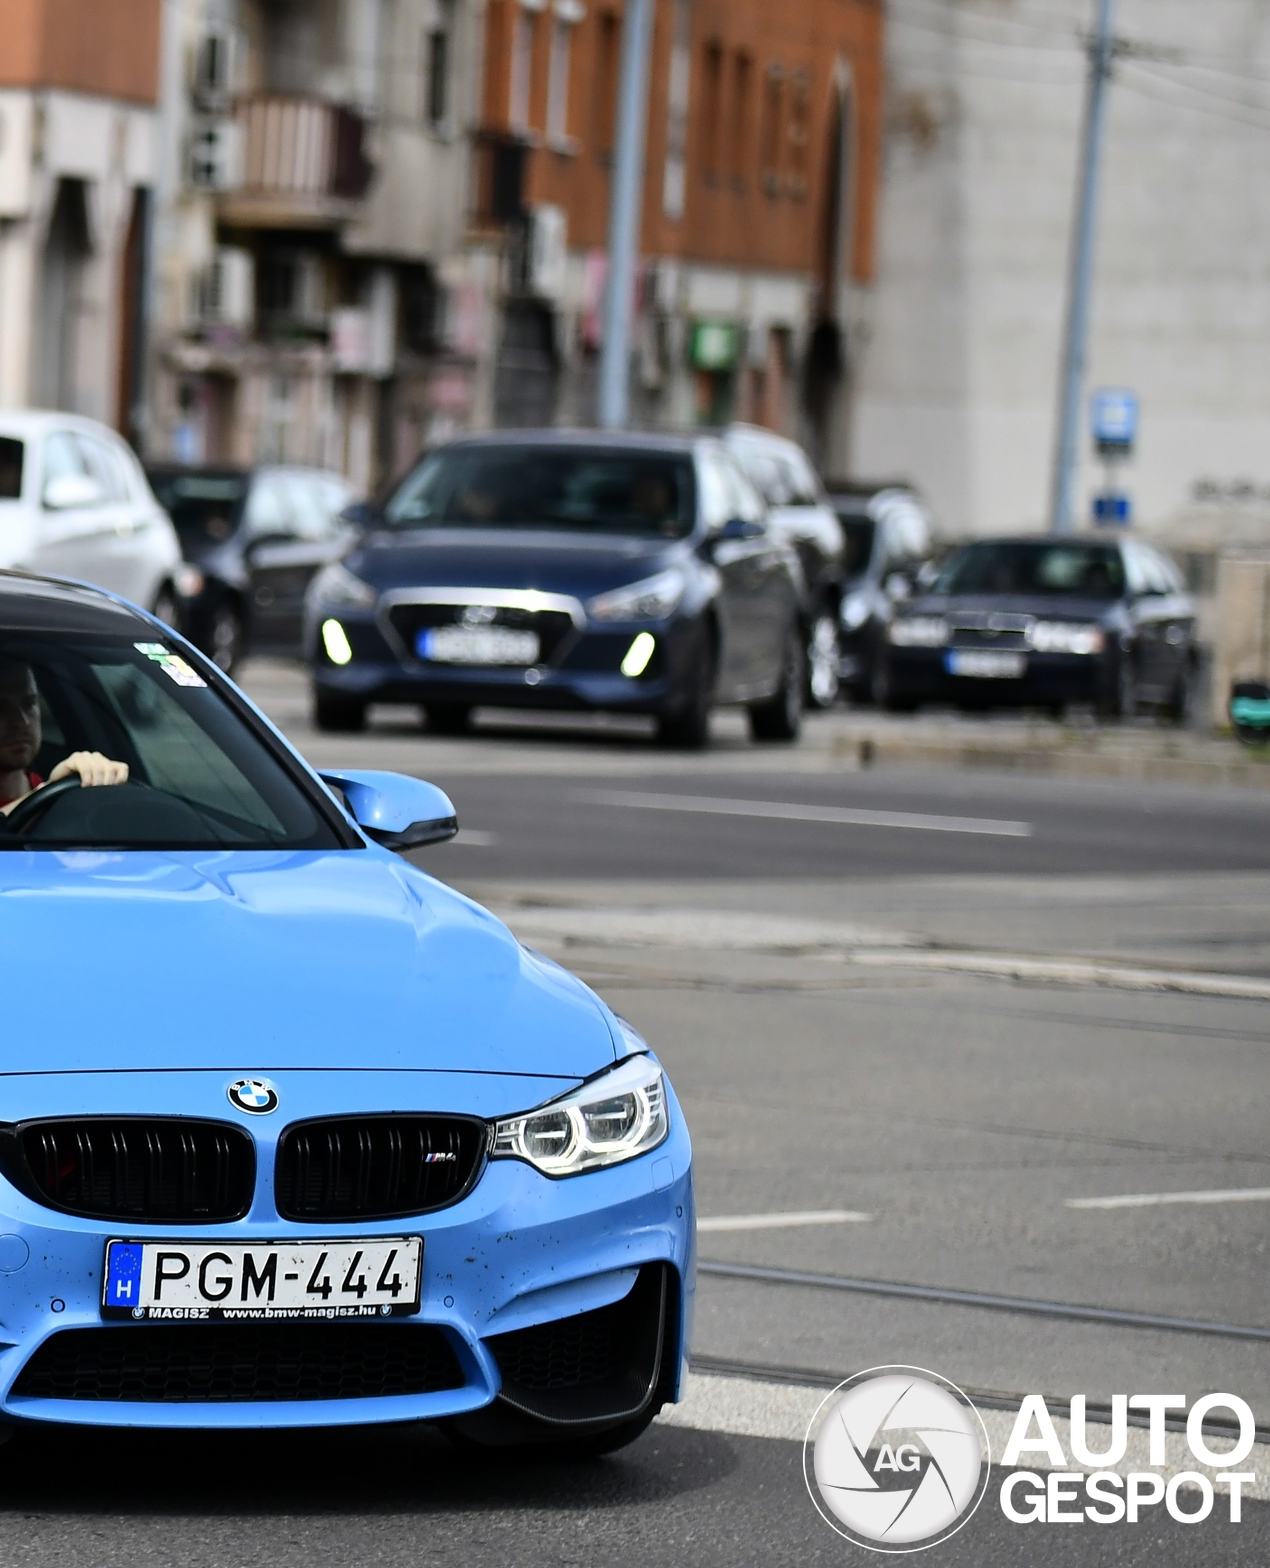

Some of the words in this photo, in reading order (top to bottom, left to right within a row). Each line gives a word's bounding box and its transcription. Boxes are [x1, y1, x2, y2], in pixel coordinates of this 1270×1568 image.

[153, 1249, 403, 1302] PGM-444
[116, 1279, 132, 1299] H
[148, 1308, 210, 1319] MAGISZ
[223, 1305, 377, 1319] www.bmw-magisz.hu
